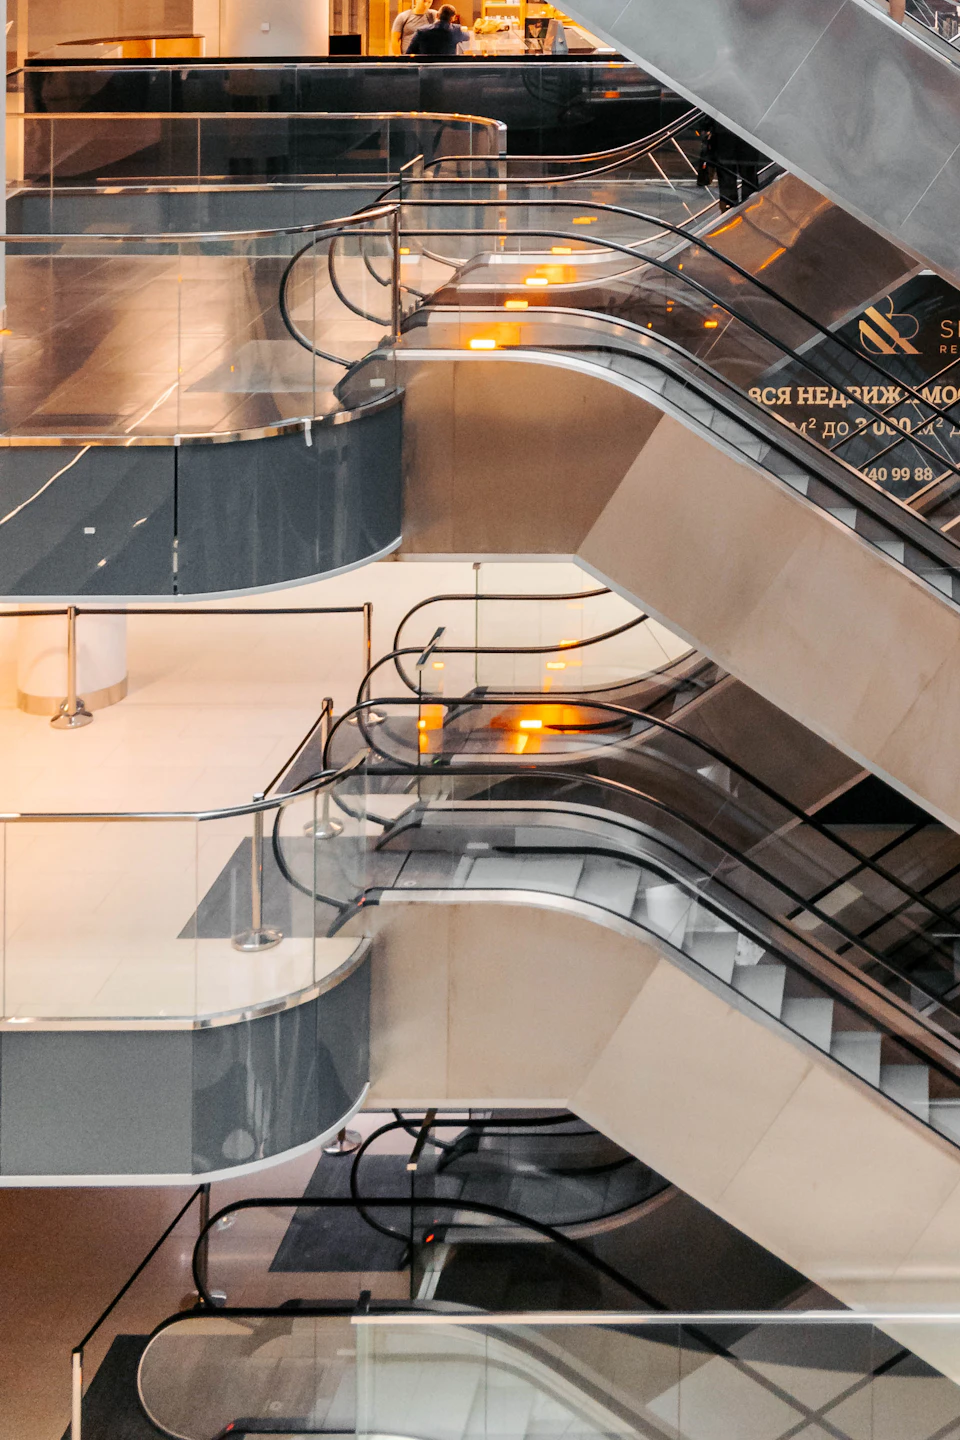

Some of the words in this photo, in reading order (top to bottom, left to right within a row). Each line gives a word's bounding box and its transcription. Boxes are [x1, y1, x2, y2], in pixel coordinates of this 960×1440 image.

[748, 386, 792, 405] ВСЯ
[822, 421, 849, 439] до
[891, 467, 911, 481] 99
[914, 467, 933, 481] 88
